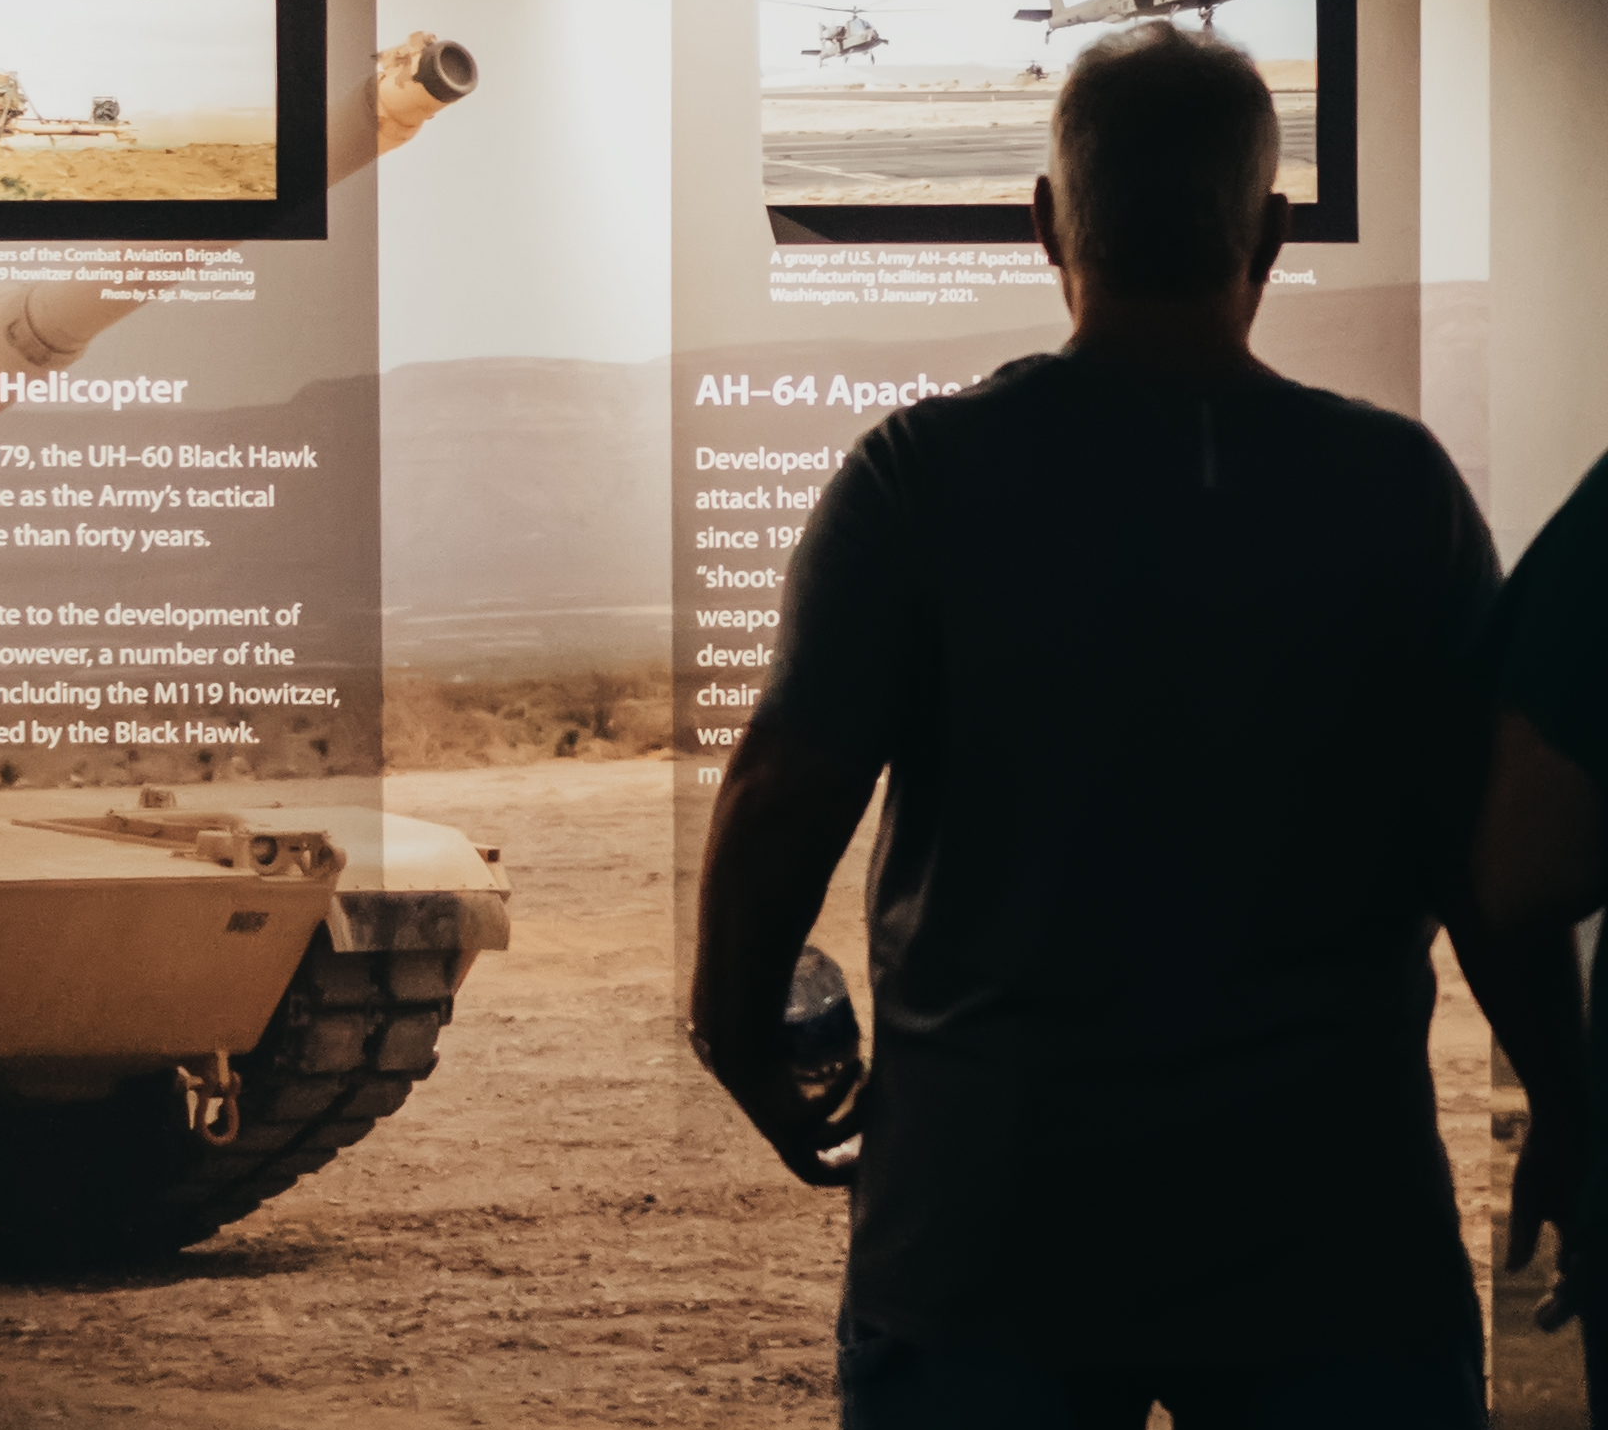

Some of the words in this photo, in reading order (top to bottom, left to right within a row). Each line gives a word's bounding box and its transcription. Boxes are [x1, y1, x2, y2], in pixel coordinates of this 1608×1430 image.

[769, 268, 876, 288] manufacturing
[877, 268, 937, 284] facilities
[937, 271, 953, 284] at
[954, 269, 997, 286] Mesa,
[998, 268, 1060, 286] Arizona,
[1269, 269, 1317, 285] Chord,
[769, 287, 860, 306] Washington,
[862, 285, 879, 303] 13
[880, 287, 938, 306] January
[938, 287, 979, 303] 2021.
[695, 374, 819, 407] AH–64
[40, 443, 83, 468] the
[178, 443, 244, 469] Black
[248, 444, 318, 469] Hawk
[696, 447, 829, 475] Developed
[19, 489, 47, 507] as
[51, 483, 94, 507] the
[186, 484, 275, 508] tactical
[695, 485, 771, 509] attack
[13, 523, 70, 546] than
[75, 522, 136, 552] forty
[140, 529, 211, 553] years.
[696, 526, 758, 549] since
